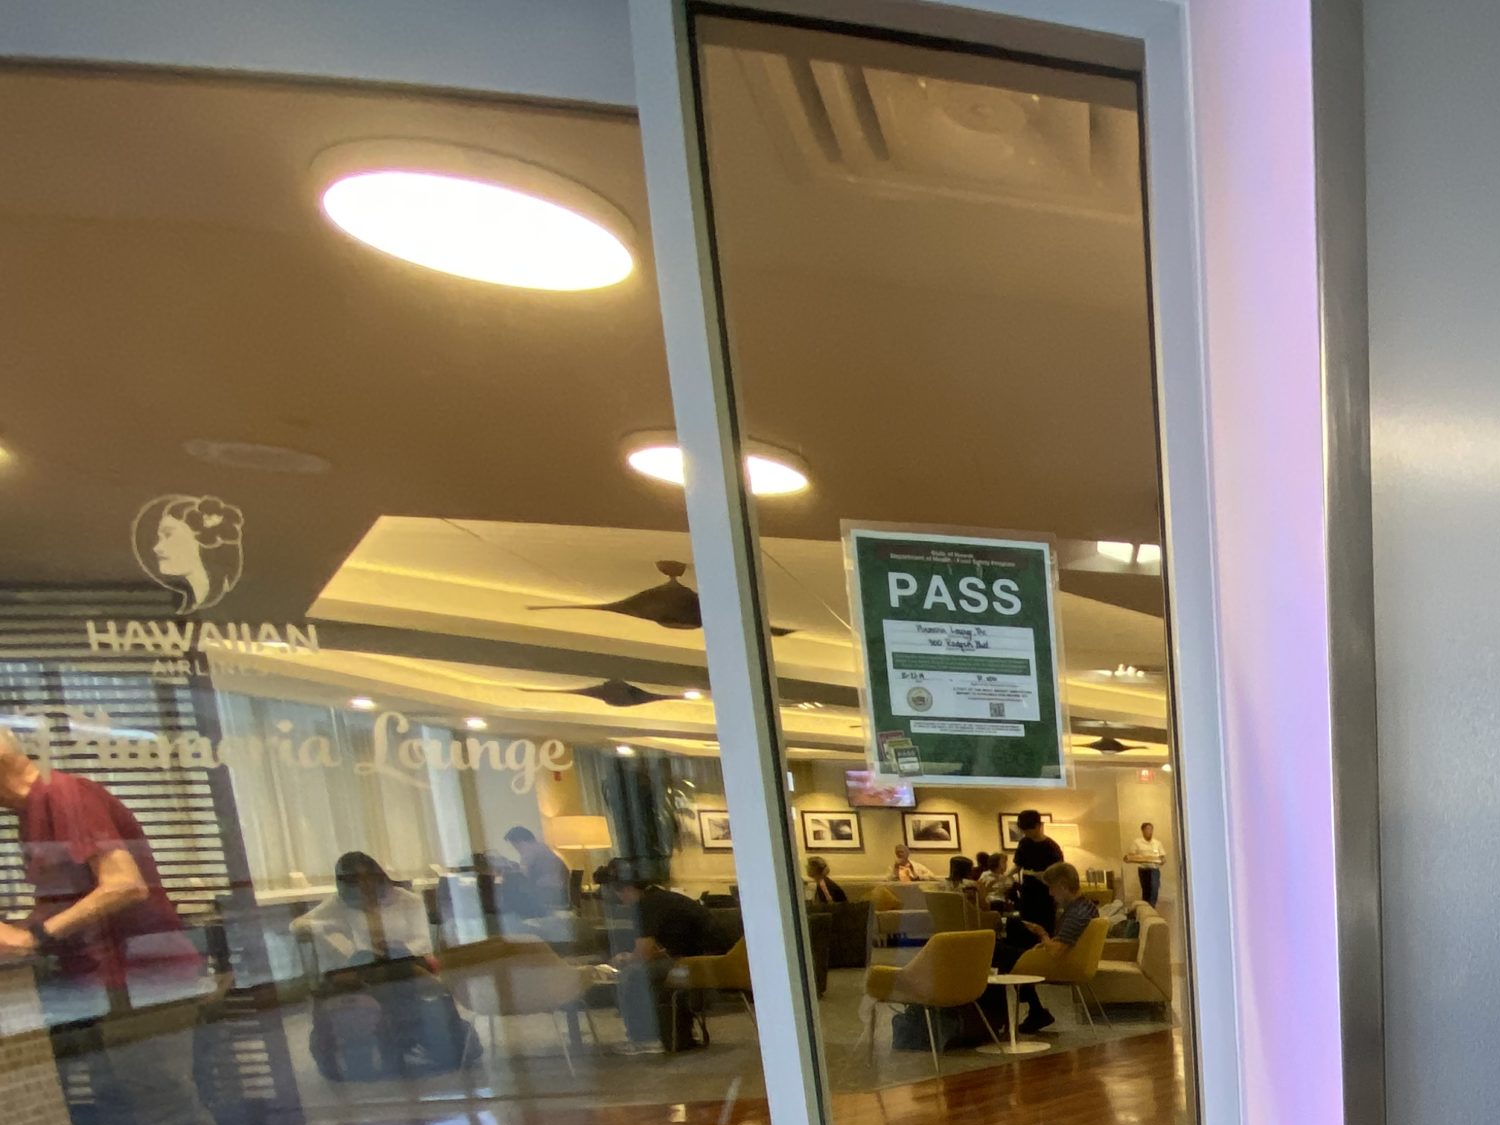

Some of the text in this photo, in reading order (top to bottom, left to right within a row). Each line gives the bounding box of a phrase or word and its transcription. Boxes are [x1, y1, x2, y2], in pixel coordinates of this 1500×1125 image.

[888, 571, 1022, 616] PASS
[86, 620, 320, 653] HAWAIIAN
[354, 711, 574, 795] Lounge
